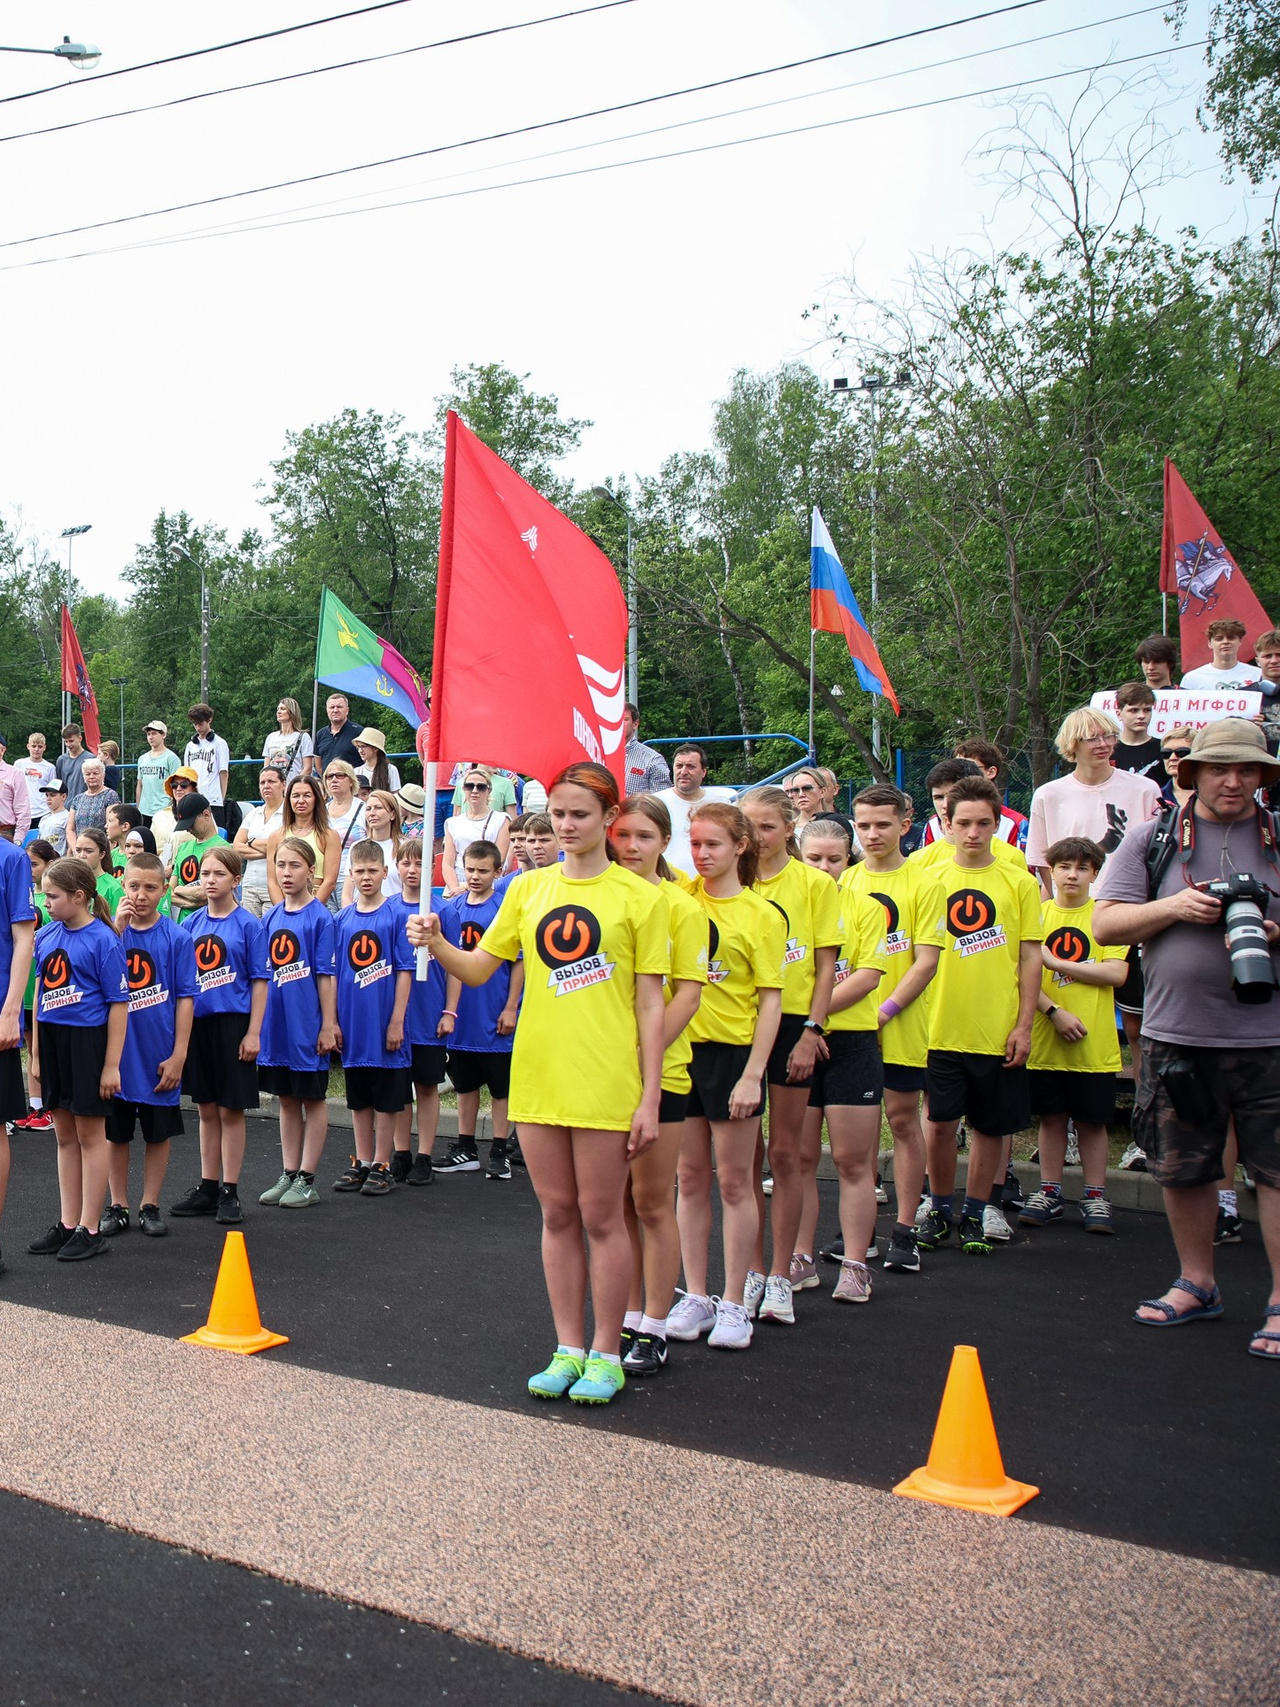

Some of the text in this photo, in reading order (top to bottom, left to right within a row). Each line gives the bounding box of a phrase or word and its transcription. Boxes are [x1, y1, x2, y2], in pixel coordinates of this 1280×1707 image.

[1188, 699, 1248, 712] МГФСО
[959, 928, 997, 946] ВЫЗОВ
[966, 934, 1007, 954] ПРИНЯТ
[200, 968, 227, 984] ВЫЗОВ
[555, 957, 601, 981] ВЫЗОВ
[203, 974, 233, 989] ПРИНЯТ
[563, 967, 609, 992] ПРИНЯ
[44, 987, 71, 1001] ВЫЗОВ
[46, 994, 79, 1010] ПРИНЯТ
[131, 993, 165, 1010] ПРИНЯТ
